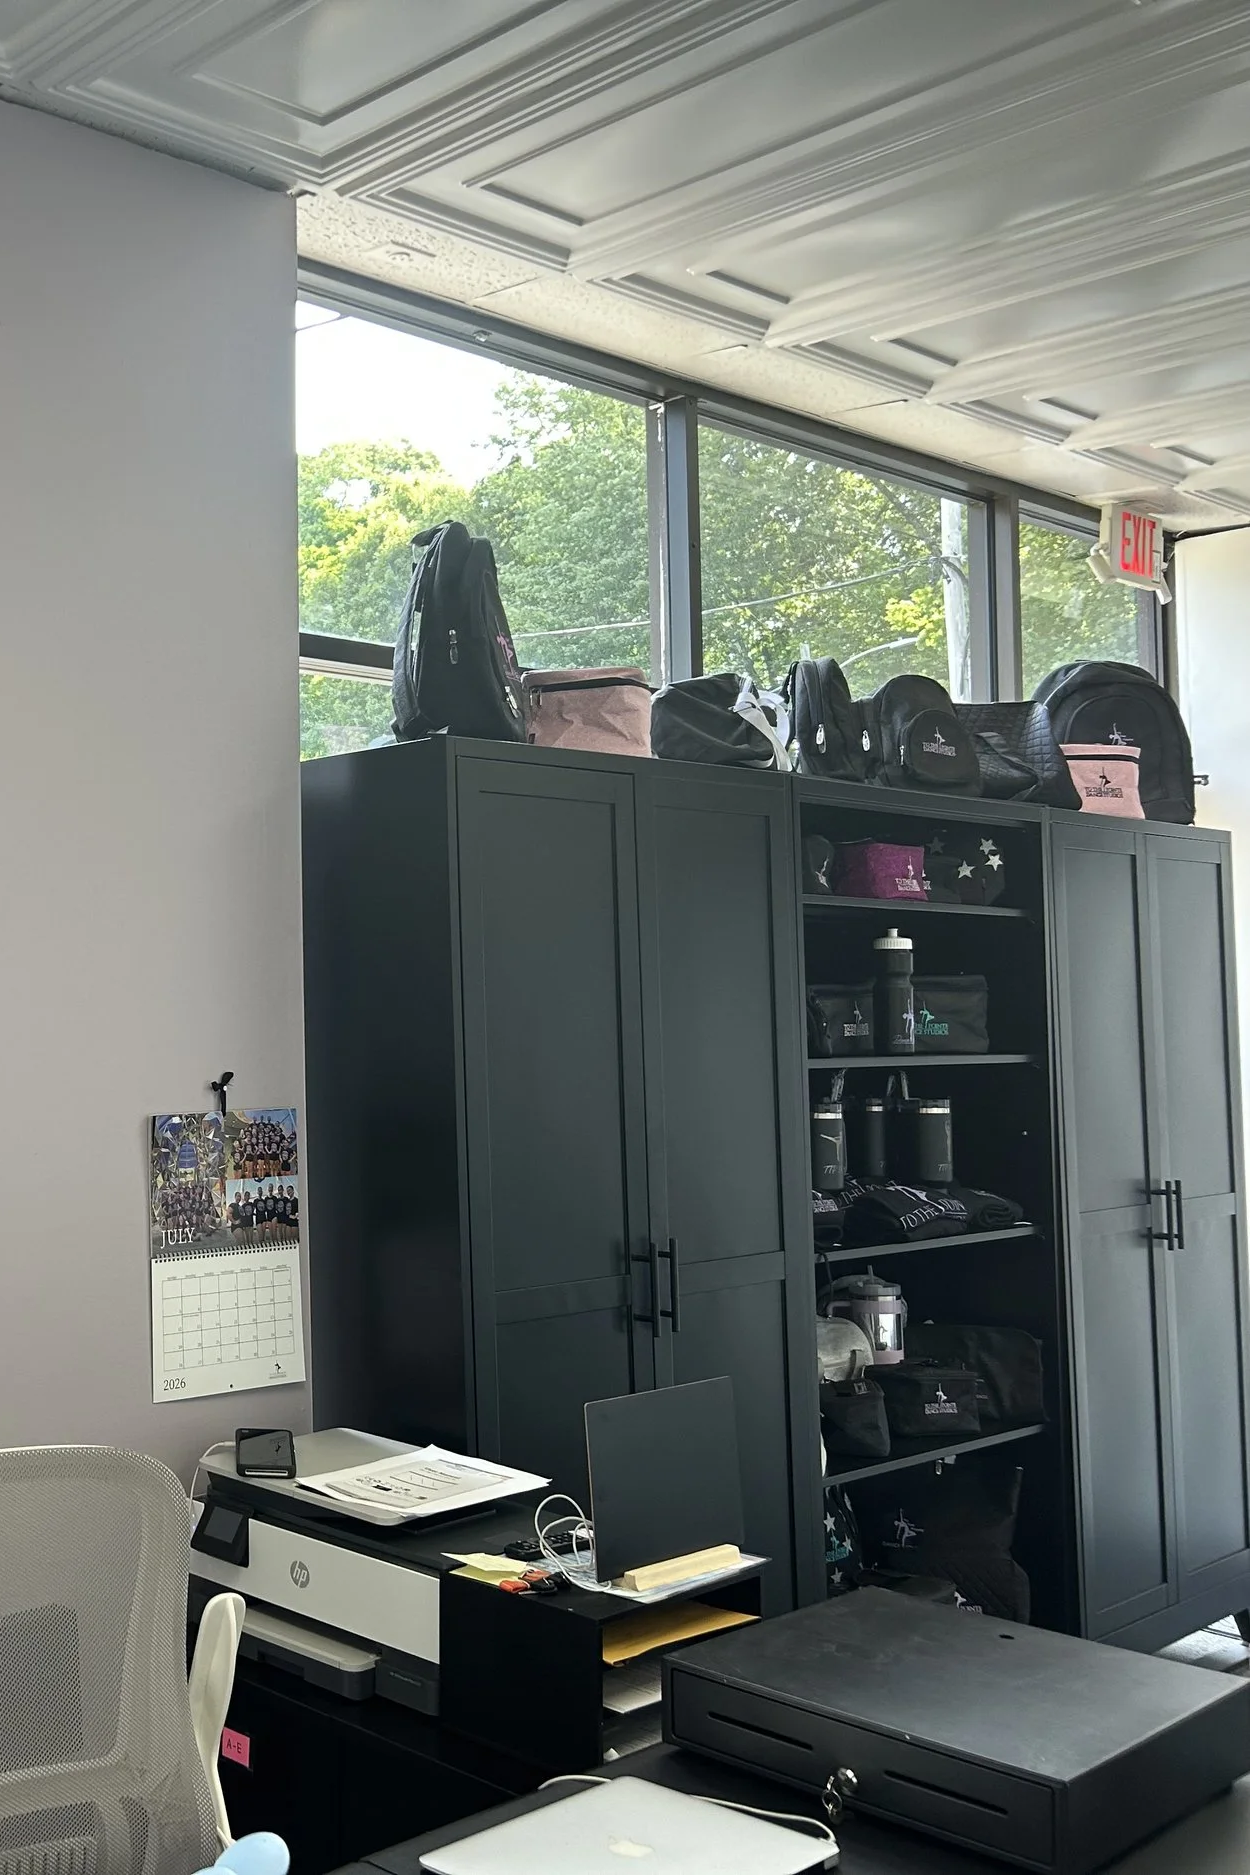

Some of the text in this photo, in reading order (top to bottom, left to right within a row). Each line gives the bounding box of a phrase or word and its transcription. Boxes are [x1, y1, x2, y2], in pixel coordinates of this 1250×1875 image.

[1120, 511, 1156, 578] EXIT
[900, 1213, 918, 1230] TO
[912, 1205, 939, 1222] THE
[160, 1227, 196, 1249] JULY
[163, 1377, 186, 1391] 2026
[292, 1560, 308, 1588] hp
[226, 1738, 242, 1754] A-E
